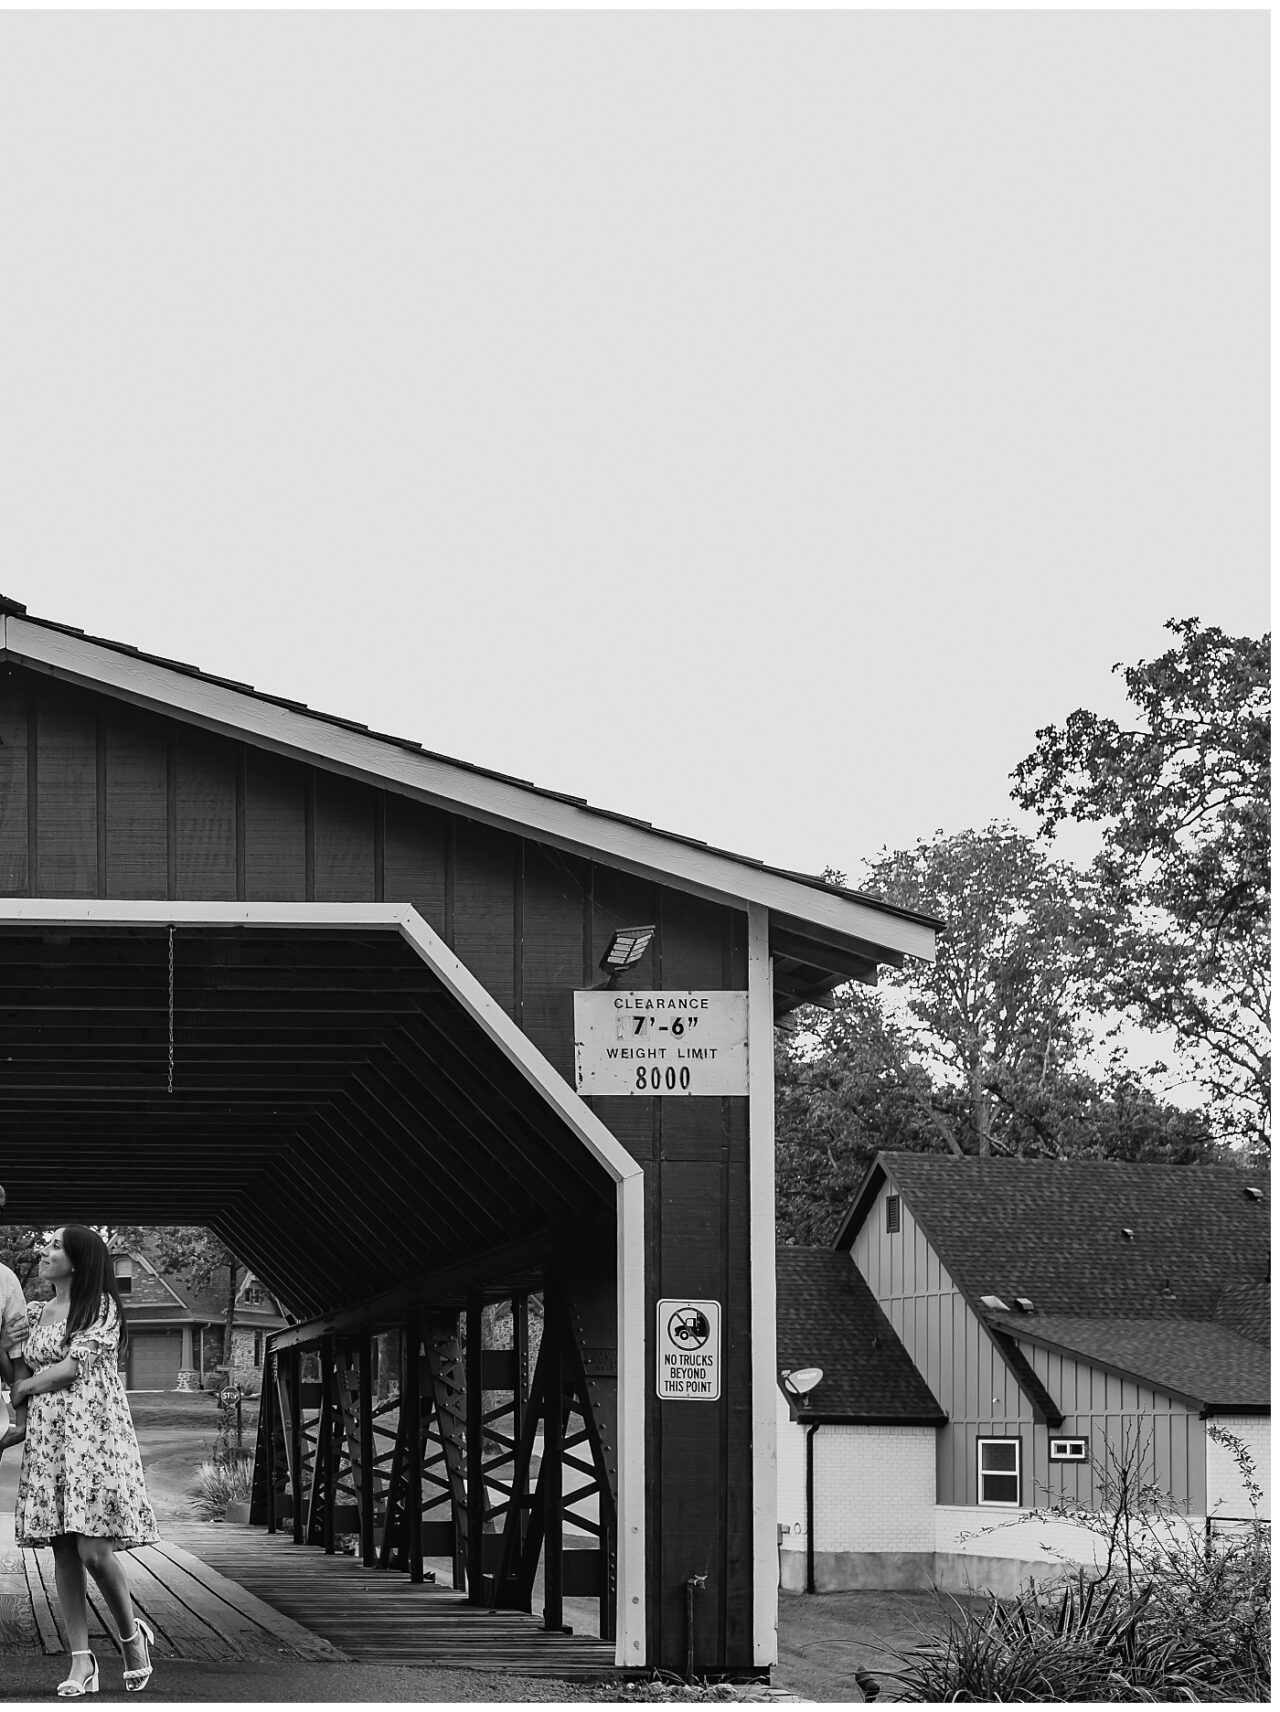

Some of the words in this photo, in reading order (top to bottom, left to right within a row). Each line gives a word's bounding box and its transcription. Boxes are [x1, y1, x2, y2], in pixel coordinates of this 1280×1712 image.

[613, 998, 709, 1009] CLEARANCE
[606, 1048, 667, 1059] WEIGHT
[677, 1048, 718, 1059] LIMIT
[635, 1066, 691, 1090] 8000
[664, 1354, 677, 1366] NO
[679, 1354, 713, 1366] TRUCKS
[670, 1367, 706, 1379] BEYOND
[664, 1380, 684, 1392] THIS
[686, 1381, 712, 1393] POINT
